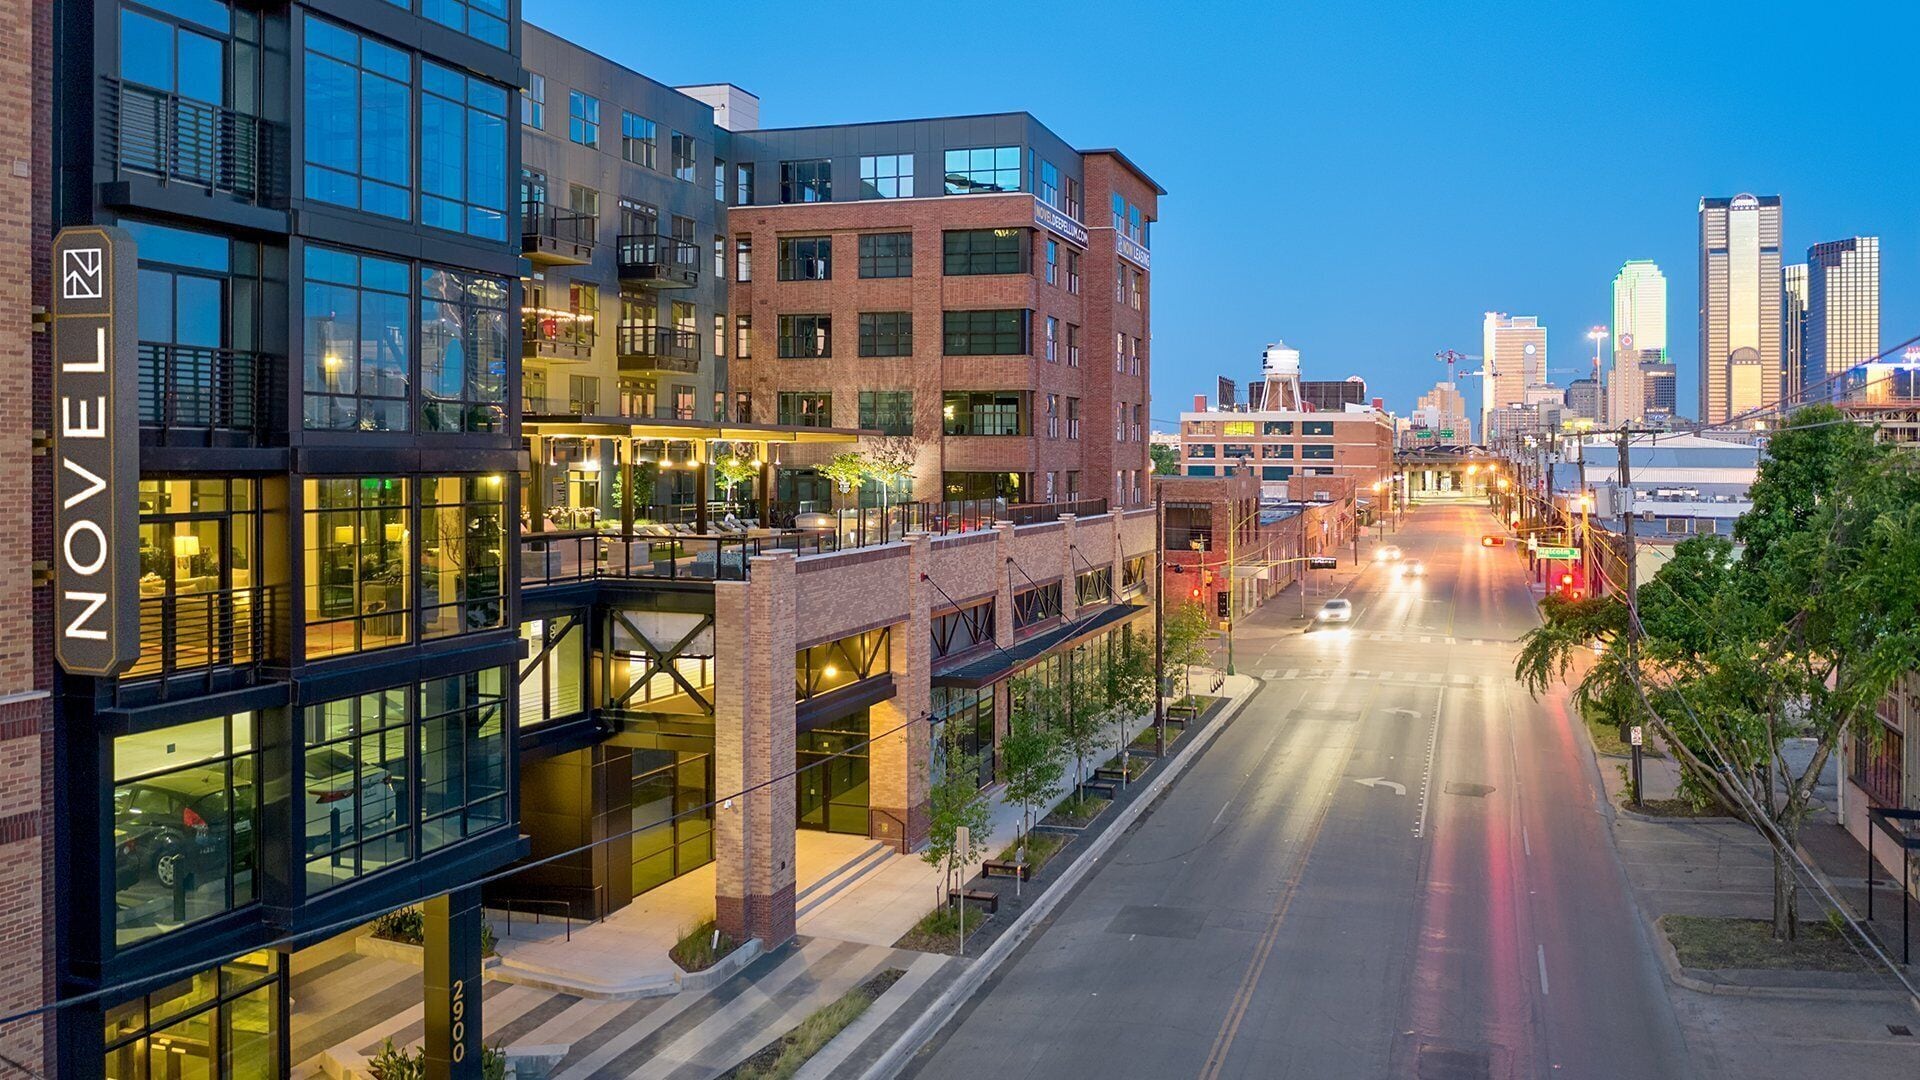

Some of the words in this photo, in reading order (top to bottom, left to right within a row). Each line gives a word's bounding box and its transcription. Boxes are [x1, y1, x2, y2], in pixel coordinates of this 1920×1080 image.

[1134, 246, 1150, 267] LEASING
[62, 327, 108, 641] NOVEL
[452, 979, 465, 1064] 2900
